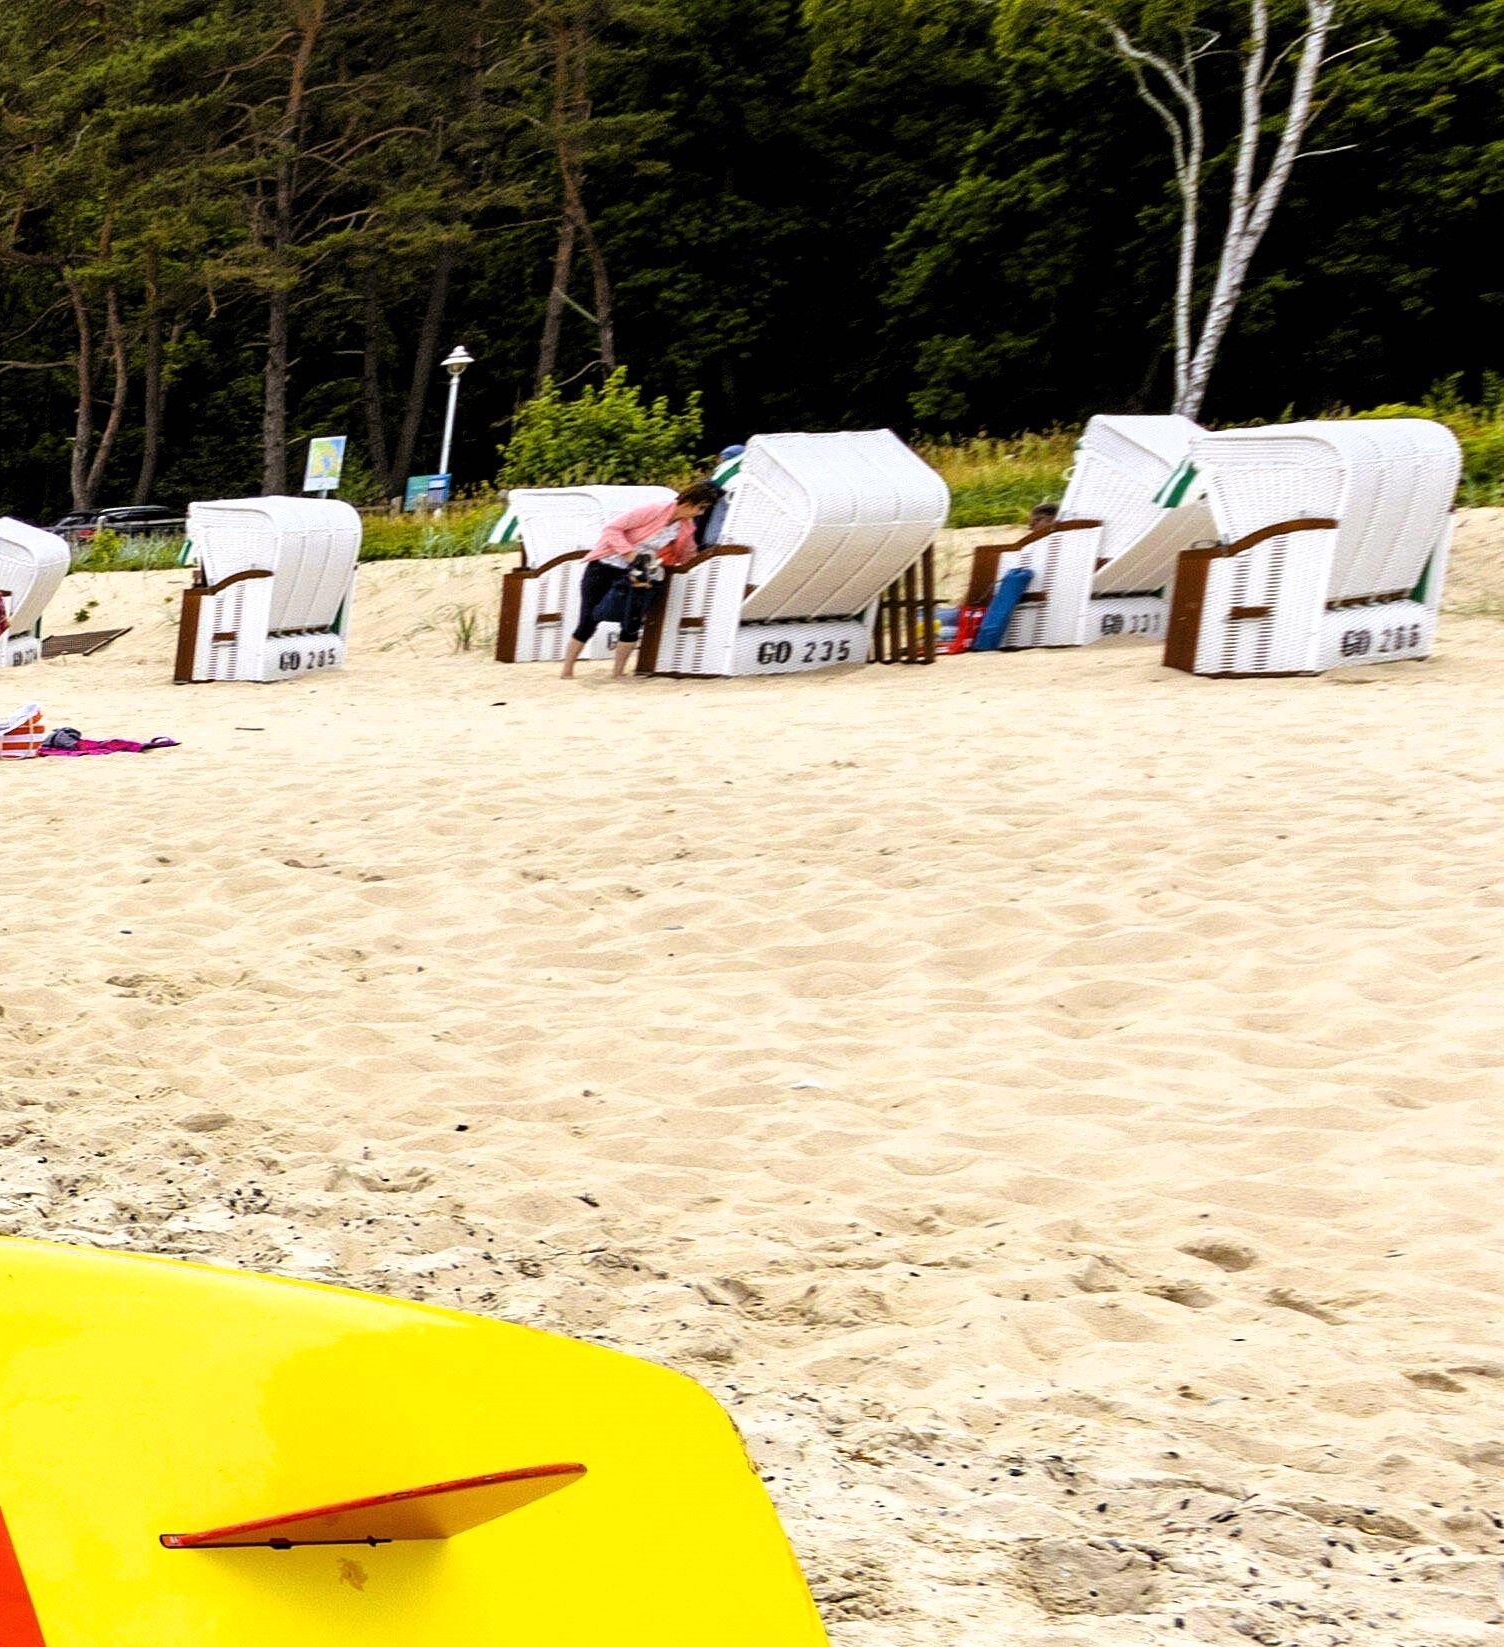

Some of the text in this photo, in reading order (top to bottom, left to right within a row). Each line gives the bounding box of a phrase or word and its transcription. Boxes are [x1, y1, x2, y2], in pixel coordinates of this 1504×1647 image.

[757, 640, 851, 665] GO 235
[1340, 629, 1371, 657] GO
[279, 648, 336, 671] GO 285
